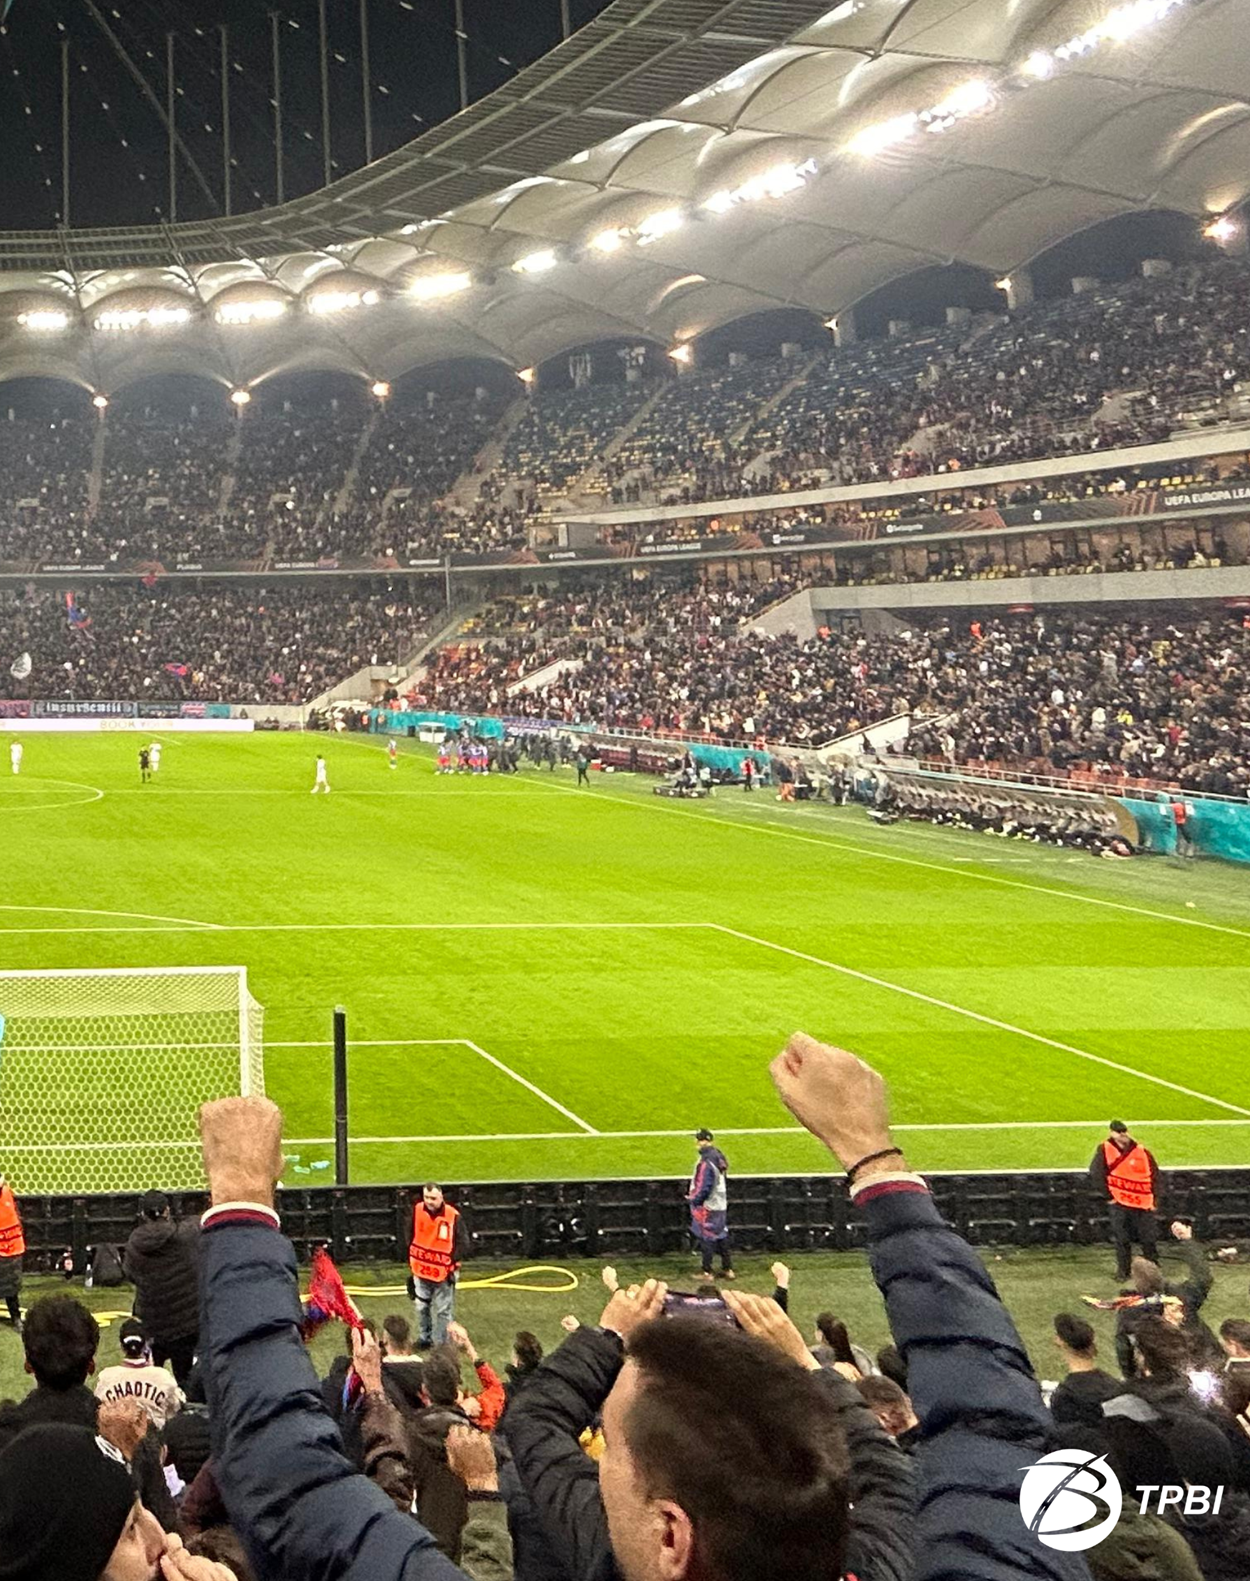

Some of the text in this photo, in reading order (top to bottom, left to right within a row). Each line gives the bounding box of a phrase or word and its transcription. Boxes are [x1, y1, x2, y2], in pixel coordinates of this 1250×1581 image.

[1164, 494, 1191, 506] UEFA
[1191, 490, 1232, 504] EUROPA
[105, 1381, 165, 1407] CHAOTIC
